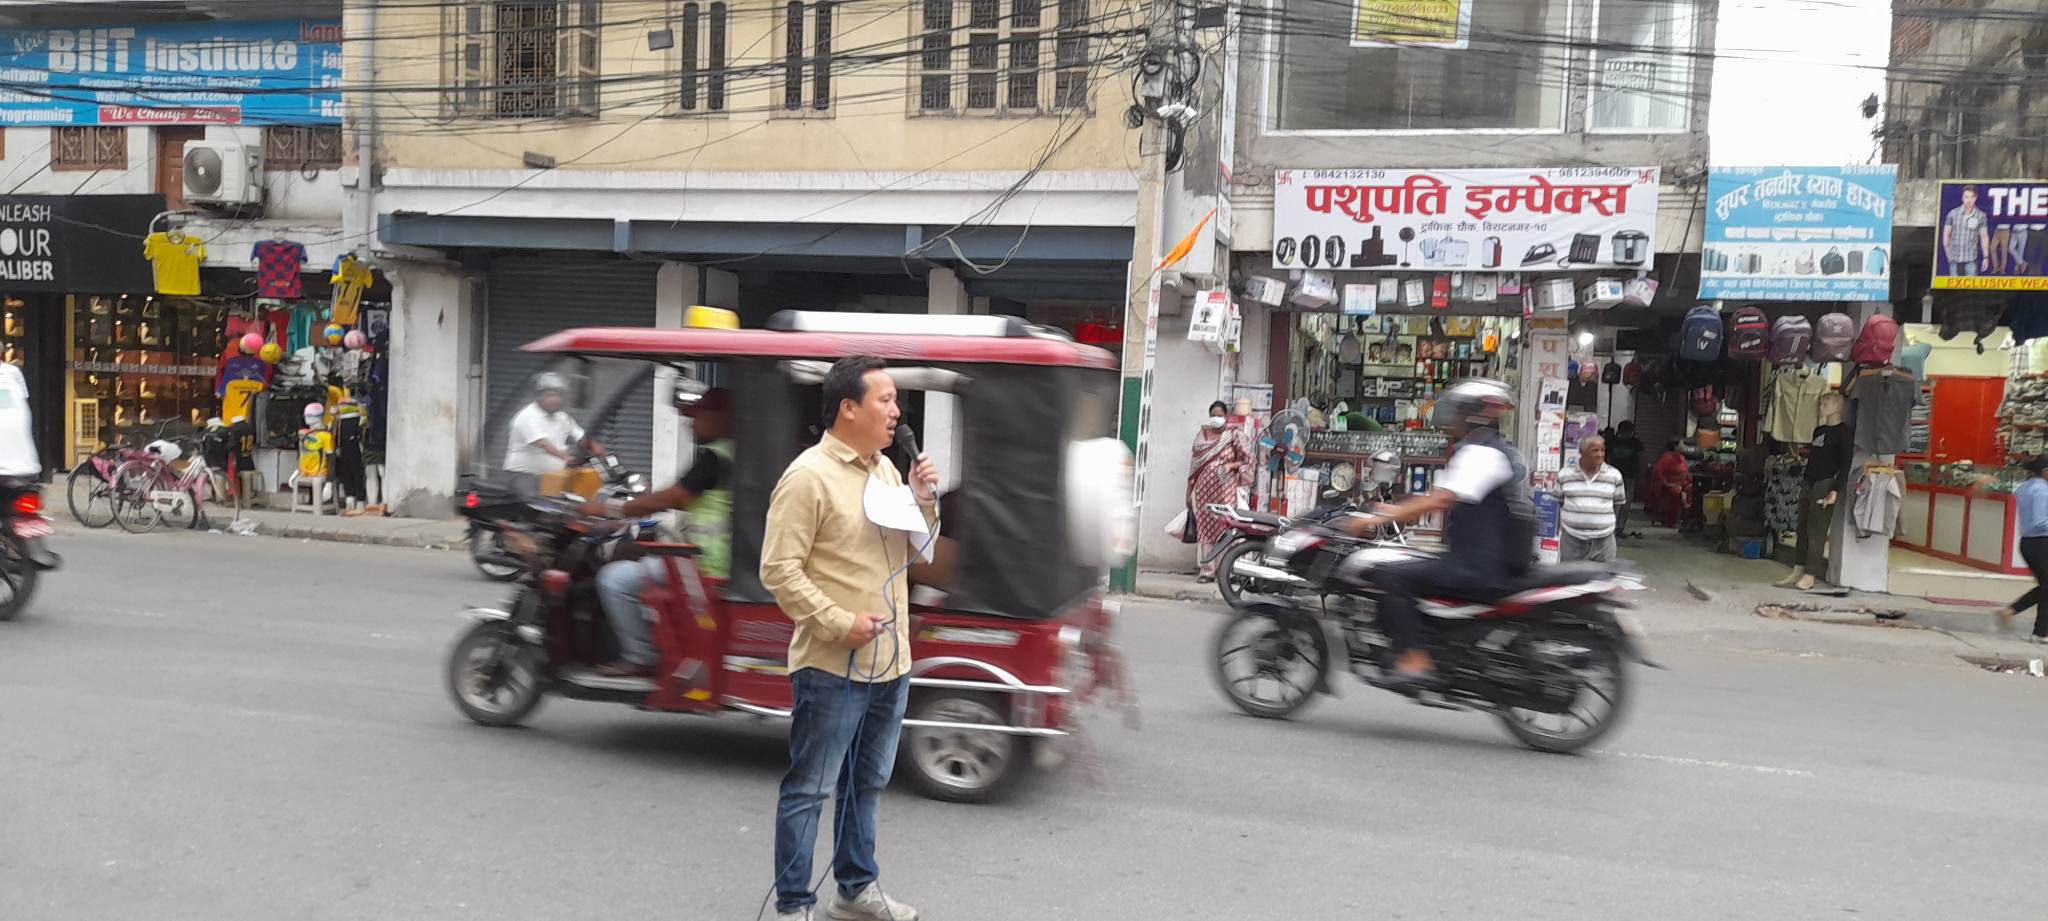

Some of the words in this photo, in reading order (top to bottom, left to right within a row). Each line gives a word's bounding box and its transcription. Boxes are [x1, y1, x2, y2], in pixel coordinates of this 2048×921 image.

[49, 27, 136, 73] BIIT
[145, 37, 298, 73] Institute
[0, 69, 49, 82] oftware
[0, 89, 51, 102] ardware
[1304, 174, 1452, 224] पशुपति
[1465, 174, 1633, 221] इम्पेक्स
[1715, 184, 1751, 221] सुपर
[1987, 187, 2048, 216] THE
[0, 260, 54, 280] ALIBER
[1946, 279, 2017, 289] EXCLUSIVE
